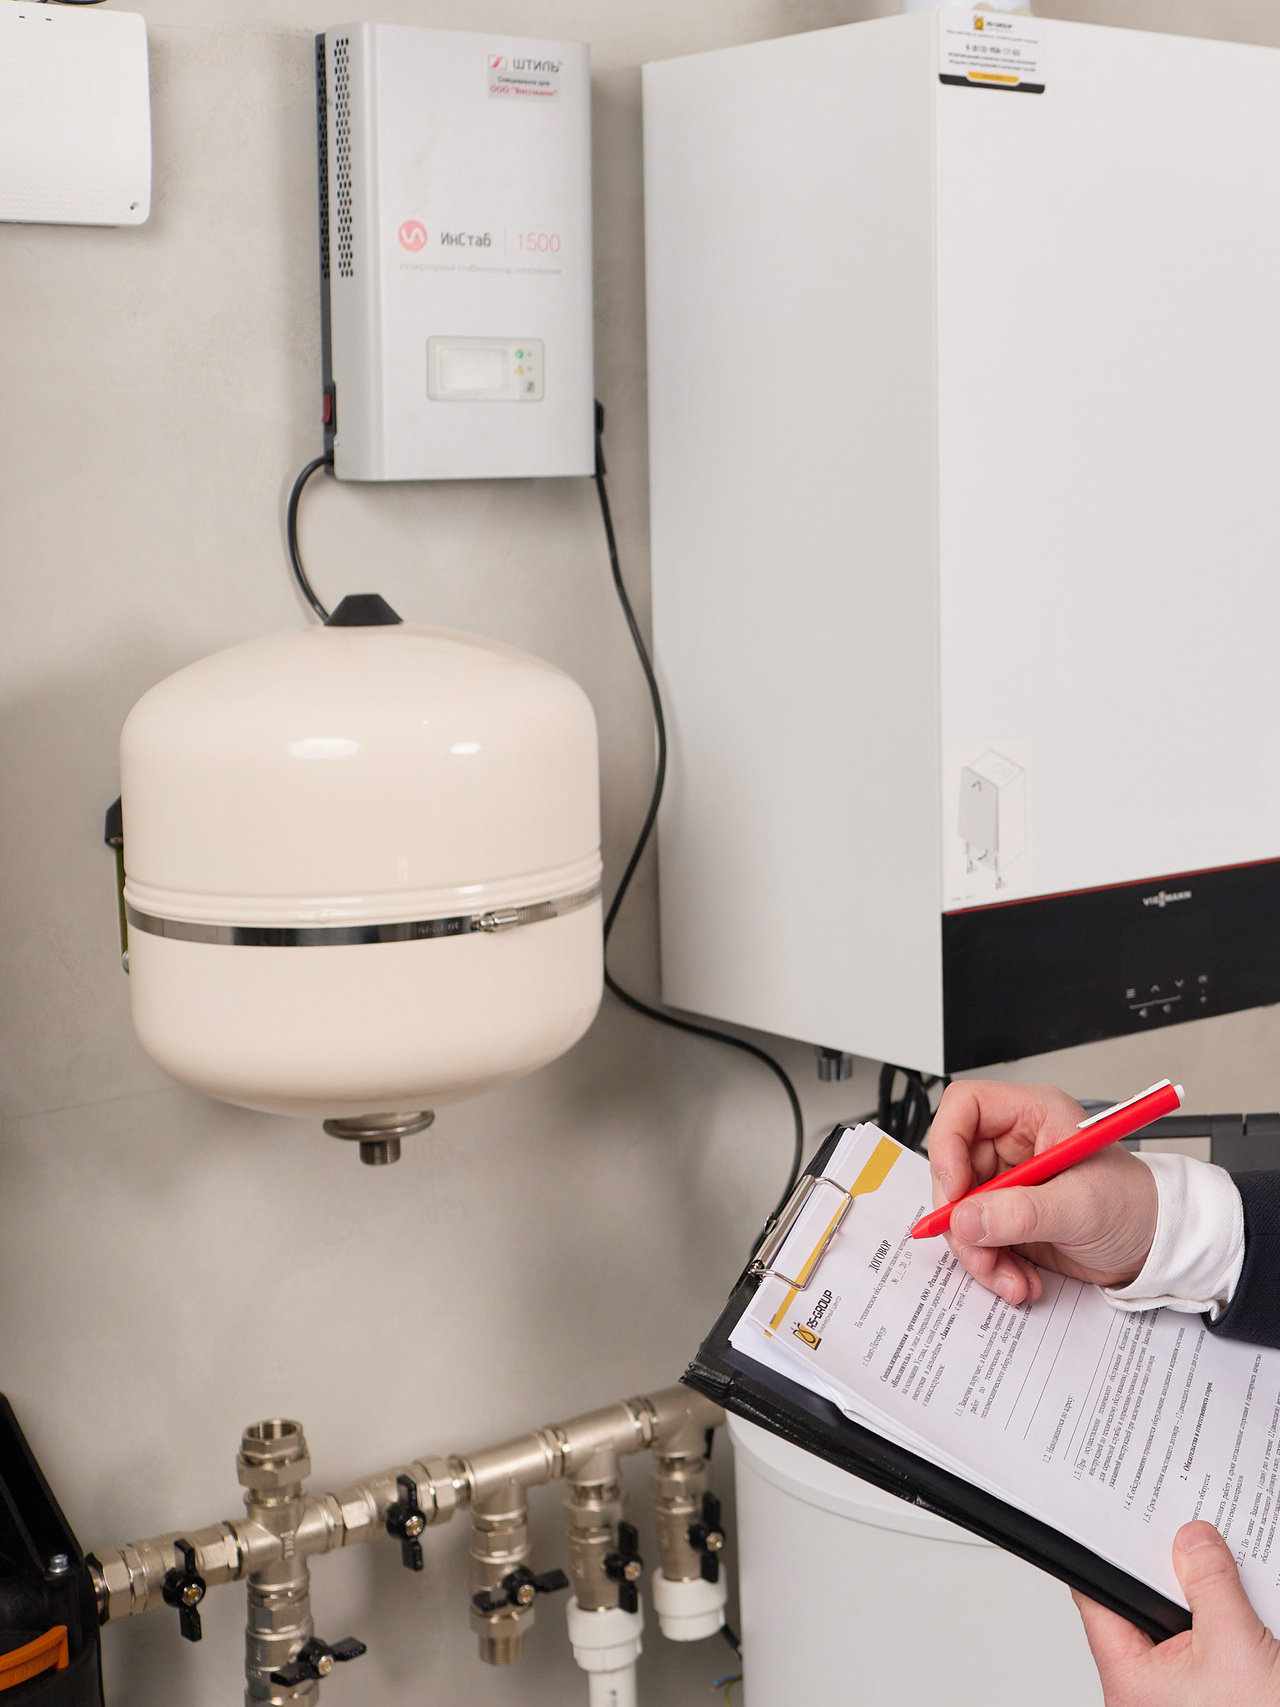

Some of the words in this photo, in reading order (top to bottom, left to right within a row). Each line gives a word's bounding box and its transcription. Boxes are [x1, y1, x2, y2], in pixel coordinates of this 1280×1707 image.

[512, 58, 560, 73] ШТИЛЬ
[440, 231, 492, 247] ИнСтаб
[518, 232, 562, 254] 1500
[868, 1239, 892, 1274] ДОГОВОР
[920, 1288, 931, 1301] ООО
[806, 1289, 833, 1330] RS-GROUP
[863, 1325, 887, 1362] Санкт-Петербург
[1214, 1500, 1227, 1528] ыполнять
